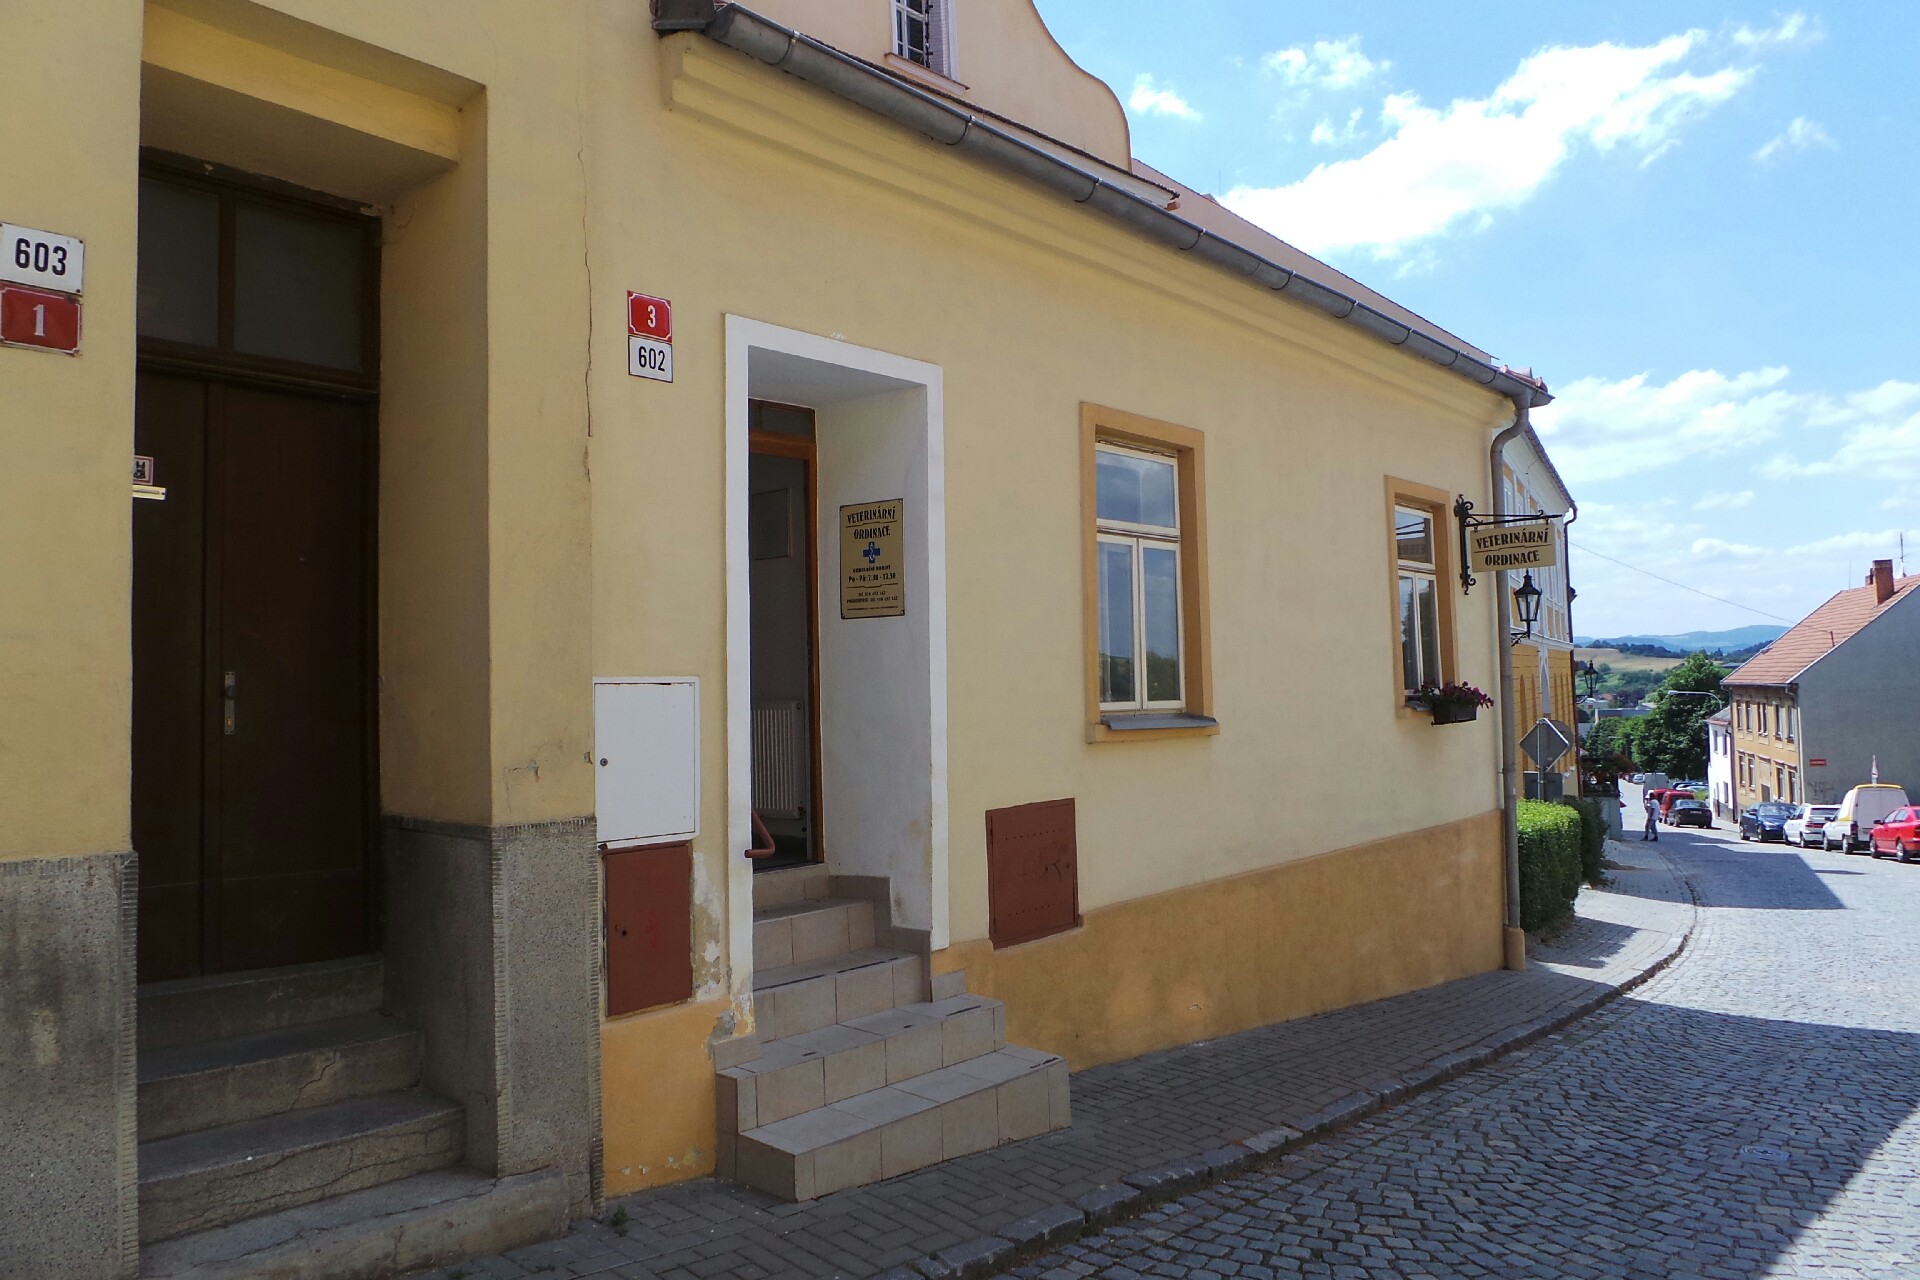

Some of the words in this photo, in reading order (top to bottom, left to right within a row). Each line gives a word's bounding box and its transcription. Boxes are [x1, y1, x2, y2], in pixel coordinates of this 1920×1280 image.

[15, 238, 67, 276] 603
[32, 303, 45, 337] 1
[647, 305, 656, 328] 3
[638, 346, 666, 372] 602
[847, 505, 896, 524] VETERINÁRNÍ
[853, 525, 891, 540] ORDINACE
[1475, 527, 1549, 549] VETERINÁRNÍ
[1484, 550, 1540, 566] ORDINACE
